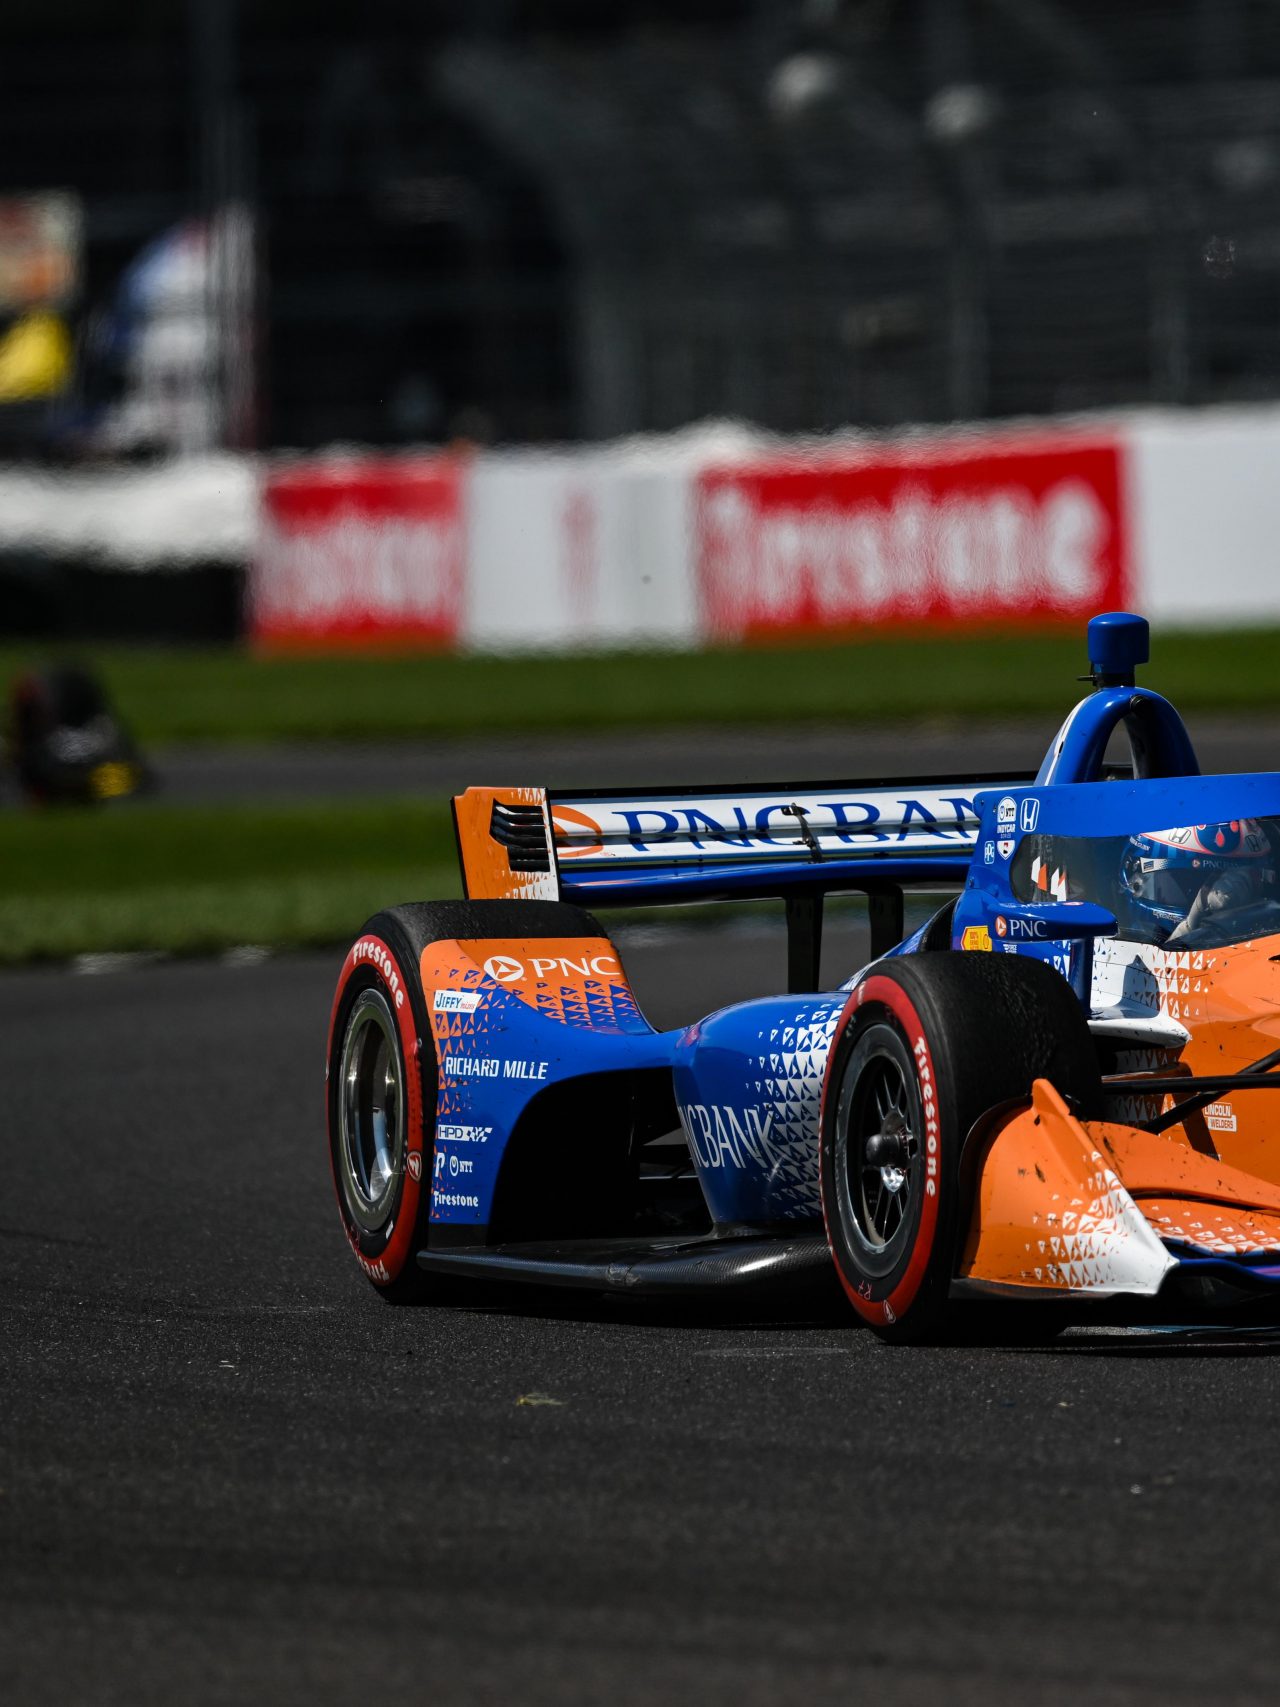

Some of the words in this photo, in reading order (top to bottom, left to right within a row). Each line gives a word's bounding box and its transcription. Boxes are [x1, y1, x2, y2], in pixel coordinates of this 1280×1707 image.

[1009, 919, 1048, 938] PNC
[353, 942, 404, 1009] Firestone
[528, 956, 621, 978] PNC
[436, 992, 463, 1009] JIFFY
[445, 1056, 500, 1078] RICHARD
[503, 1060, 549, 1080] MILLE
[914, 1036, 938, 1197] Firestone
[1204, 1103, 1231, 1117] LINCOLN
[439, 1126, 464, 1139] HPD
[1210, 1118, 1234, 1130] WELDERS
[459, 1160, 473, 1173] NTT
[433, 1190, 479, 1207] Firestone
